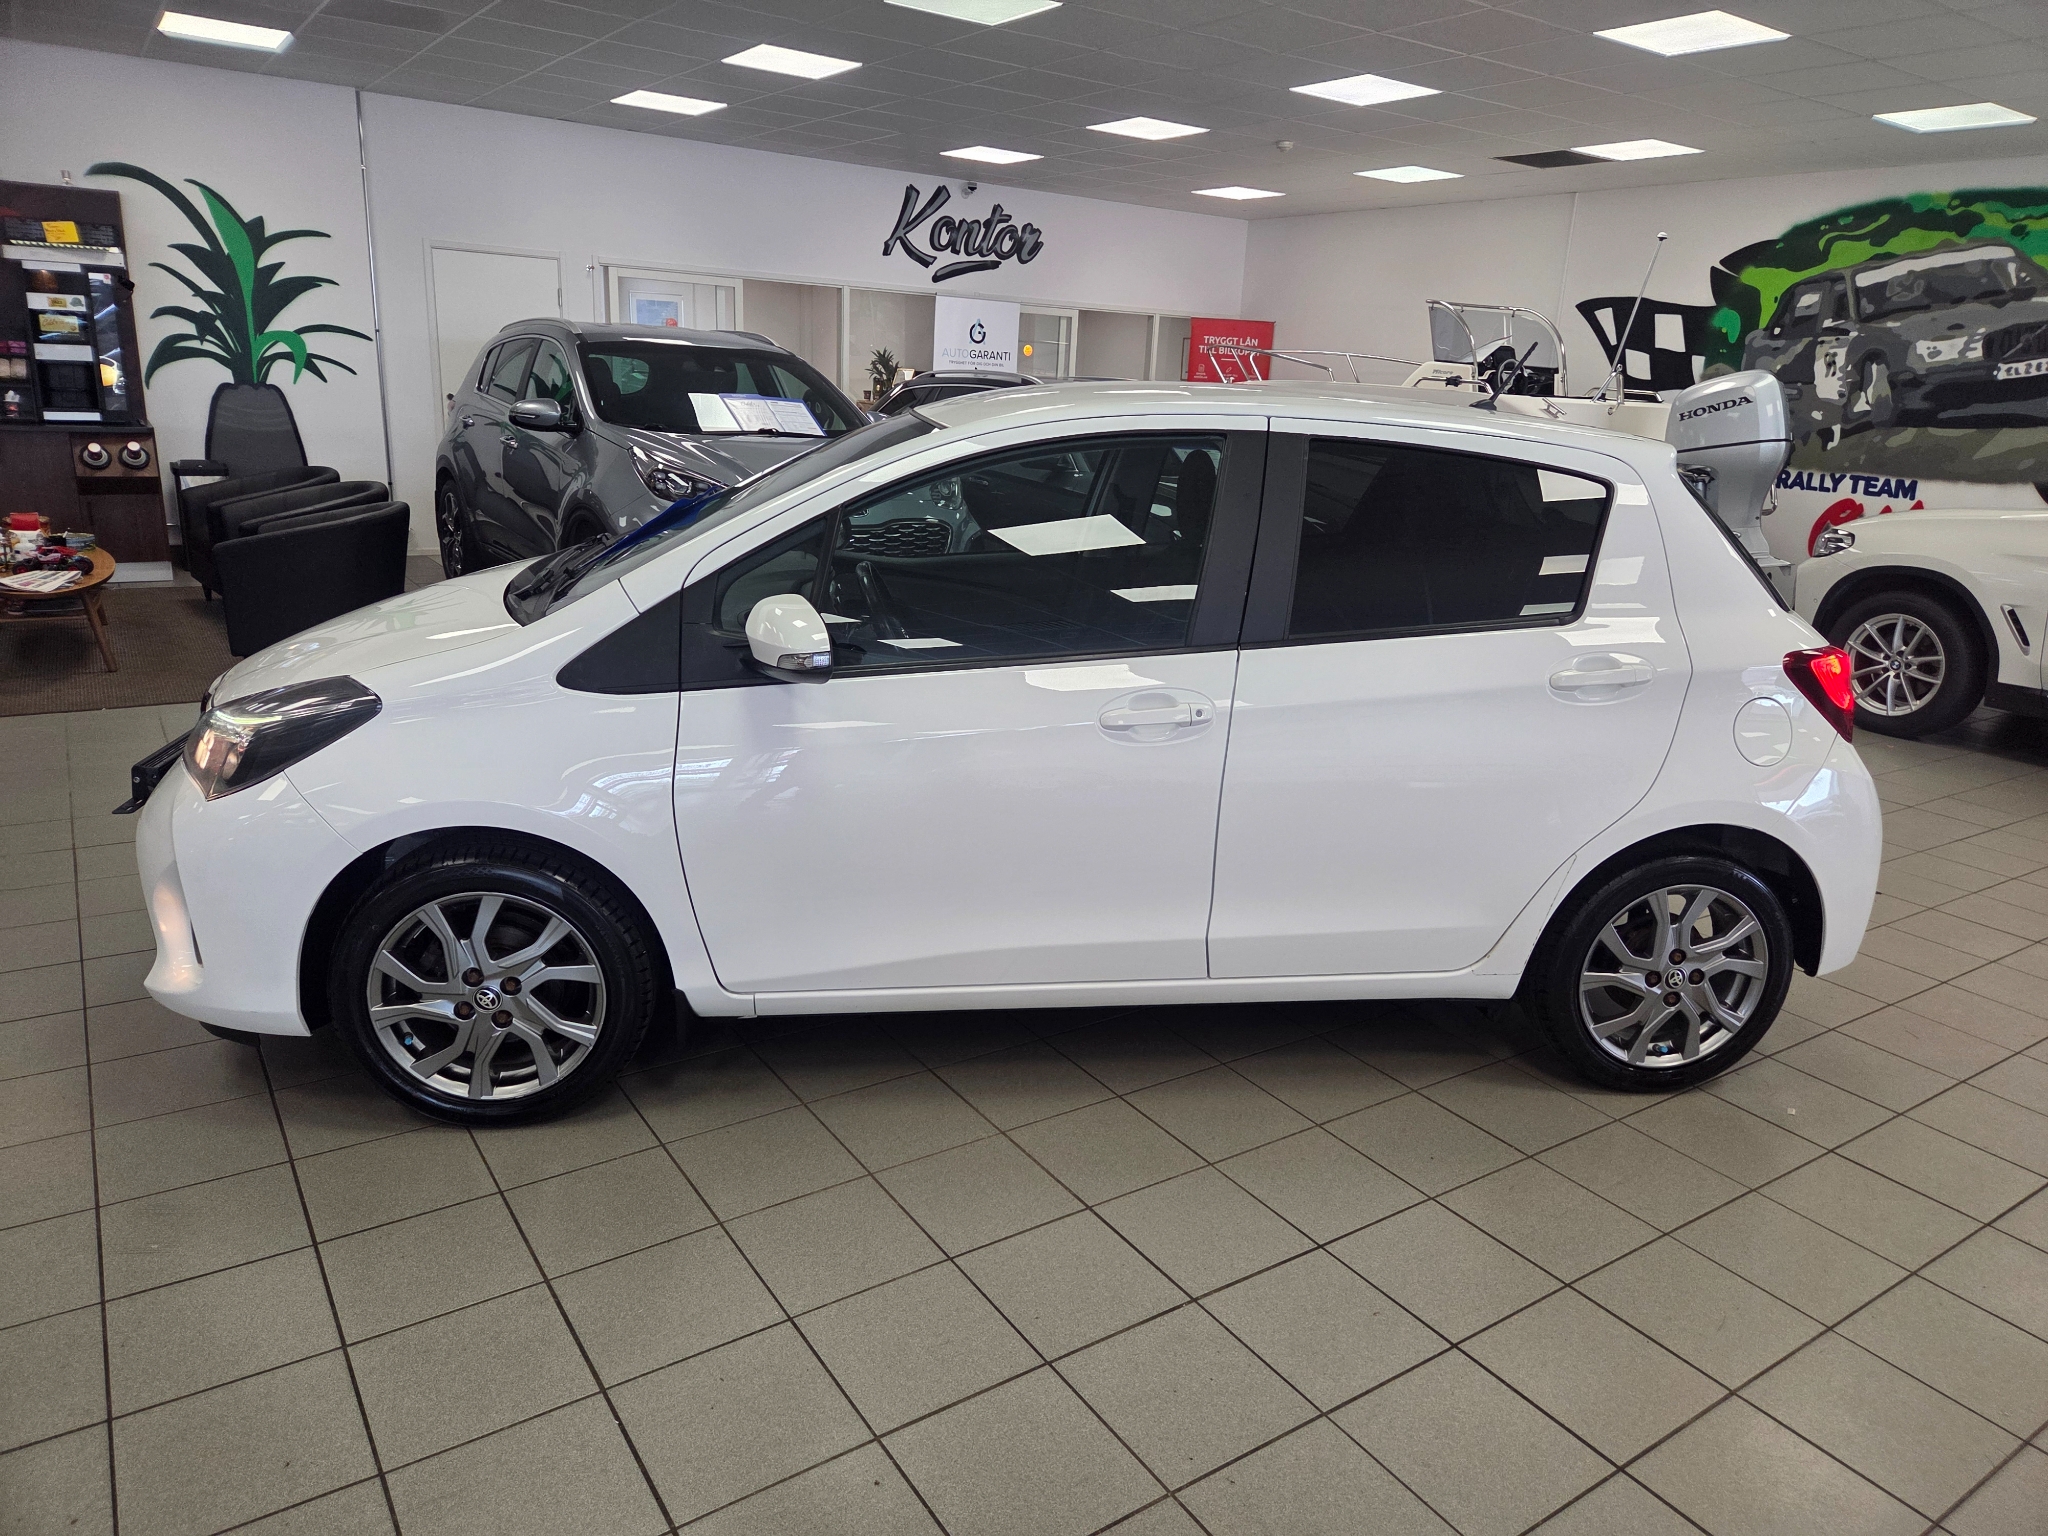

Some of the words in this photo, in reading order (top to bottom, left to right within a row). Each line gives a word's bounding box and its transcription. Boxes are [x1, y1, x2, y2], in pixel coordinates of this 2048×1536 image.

[882, 184, 1044, 269] Kontor
[1198, 345, 1217, 354] TIL
[1203, 335, 1239, 346] TRYGGT
[1240, 336, 1259, 347] LÅN
[942, 347, 1011, 361] AUTOGARANTI
[1678, 396, 1754, 422] HONDA
[1776, 470, 1846, 493] RALLY
[1849, 475, 1918, 501] TEAM
